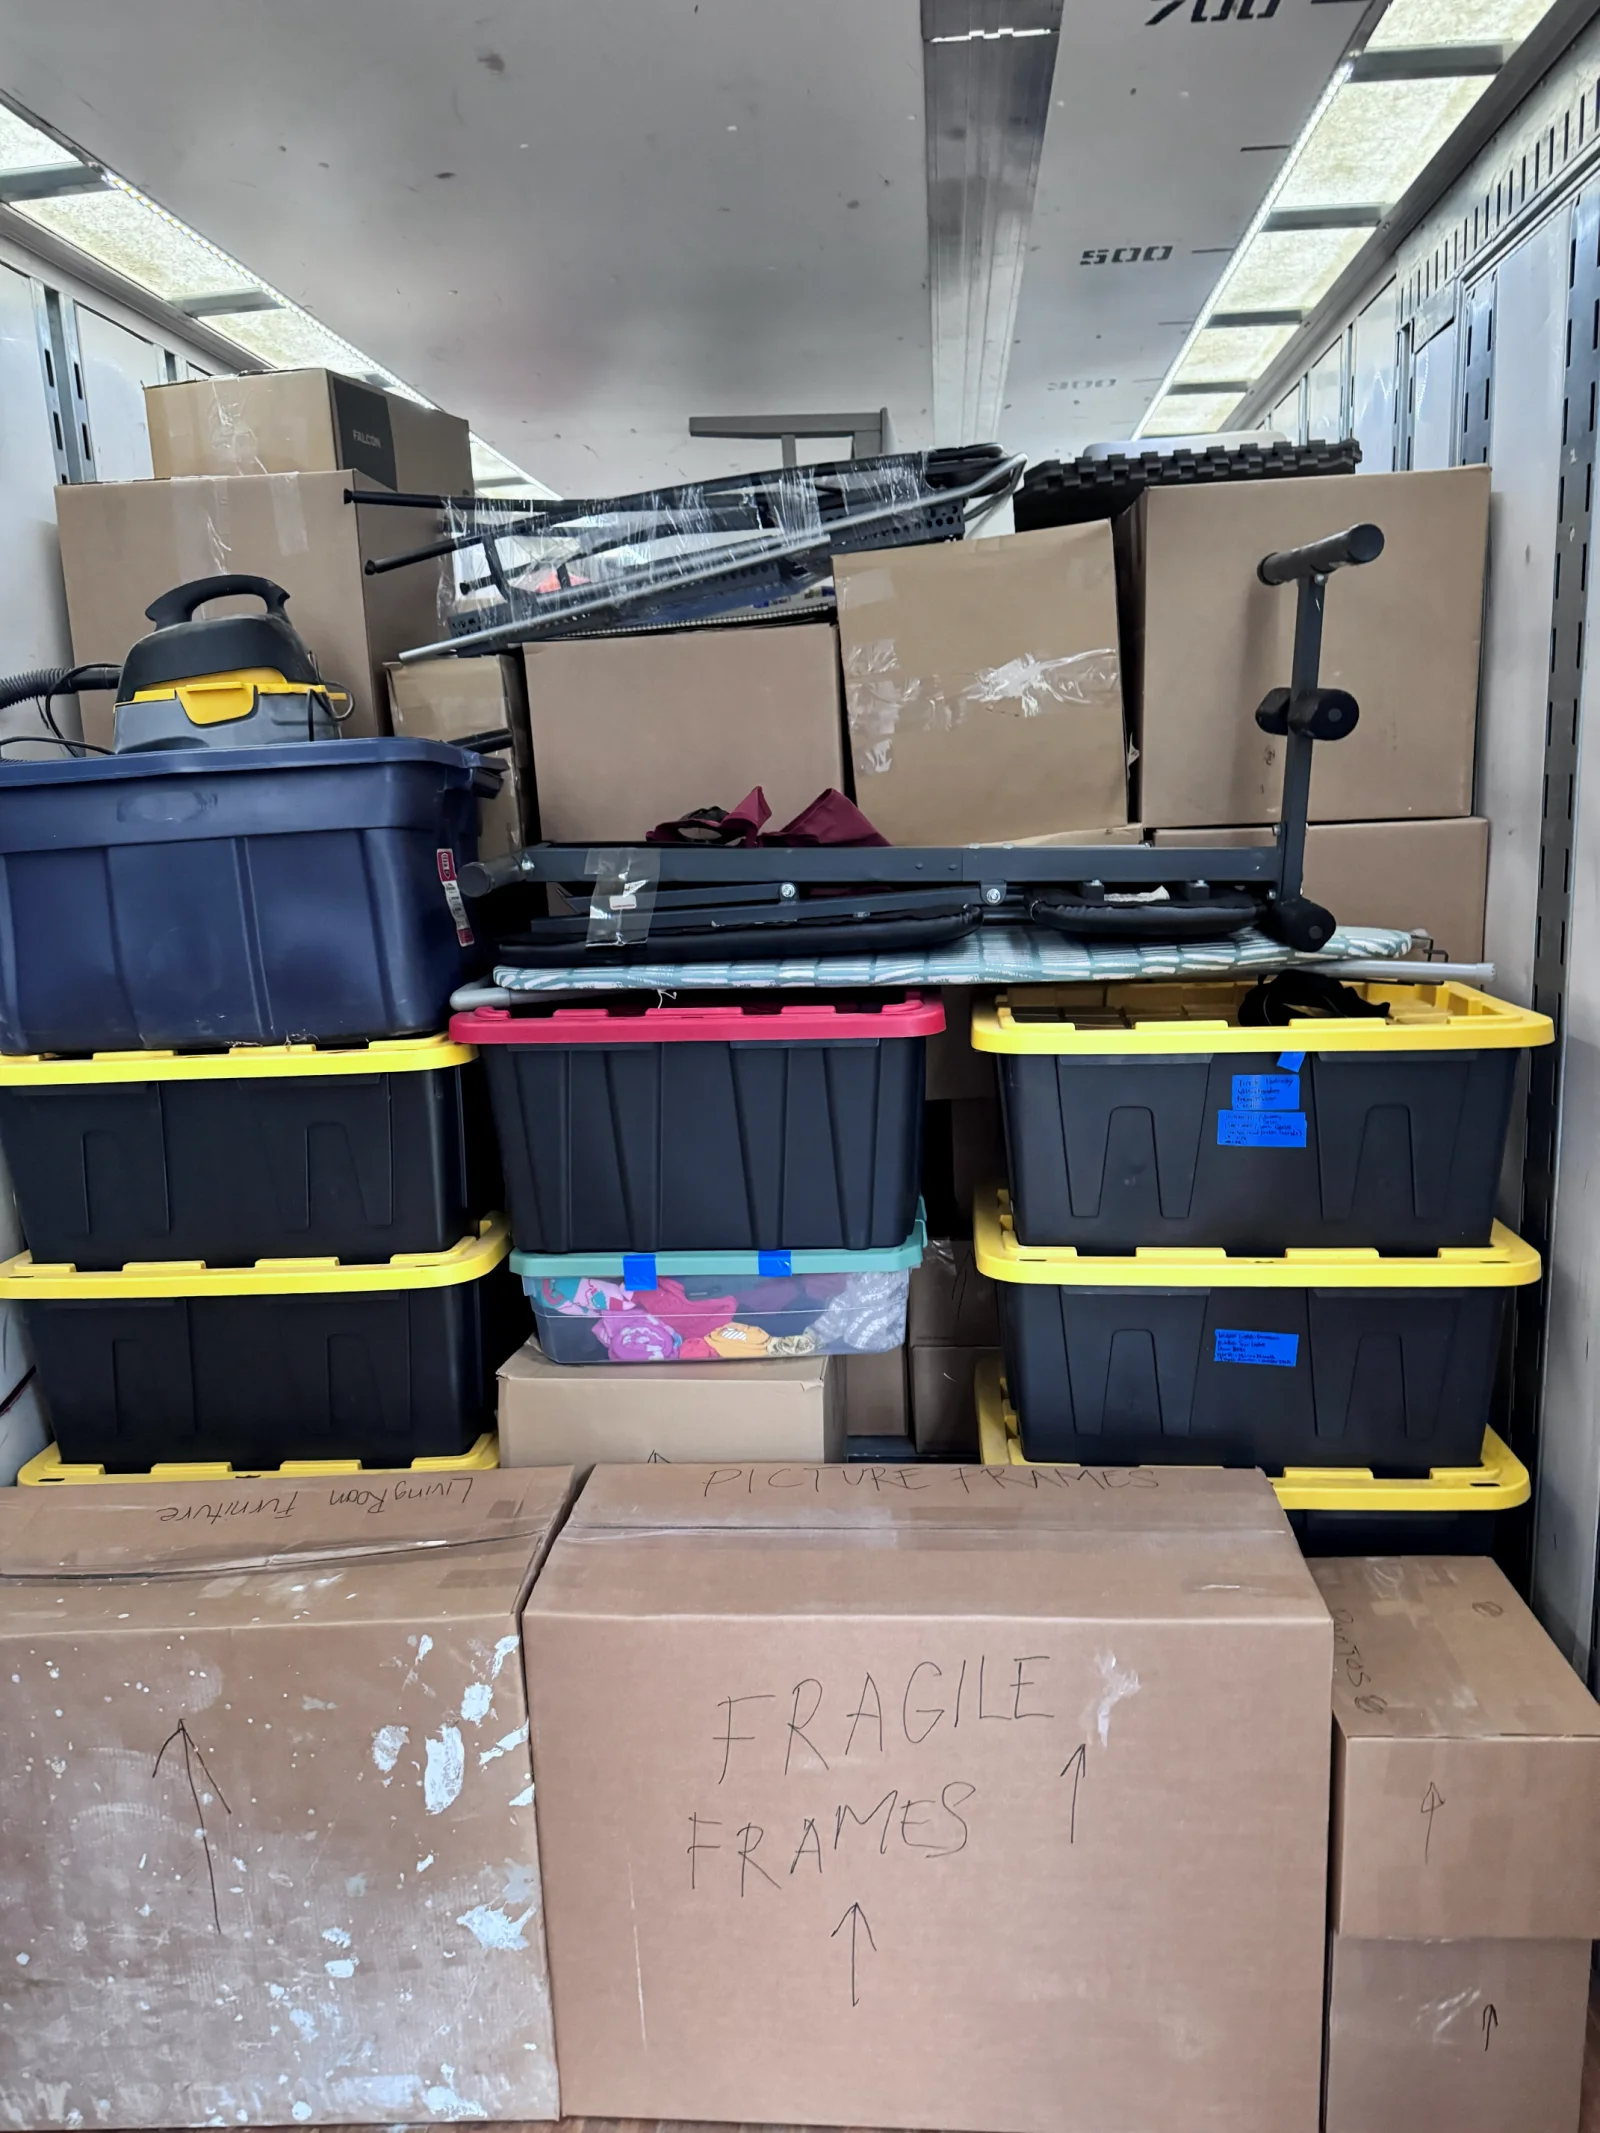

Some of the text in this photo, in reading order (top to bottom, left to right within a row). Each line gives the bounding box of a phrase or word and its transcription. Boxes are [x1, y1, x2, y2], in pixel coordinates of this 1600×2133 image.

[1080, 245, 1174, 265] 500
[701, 1466, 1161, 1497] PICTURE FRAMES
[155, 1490, 299, 1525] Furniture
[712, 1655, 1055, 1784] FRAGILE
[686, 1781, 977, 1897] FRAMES
